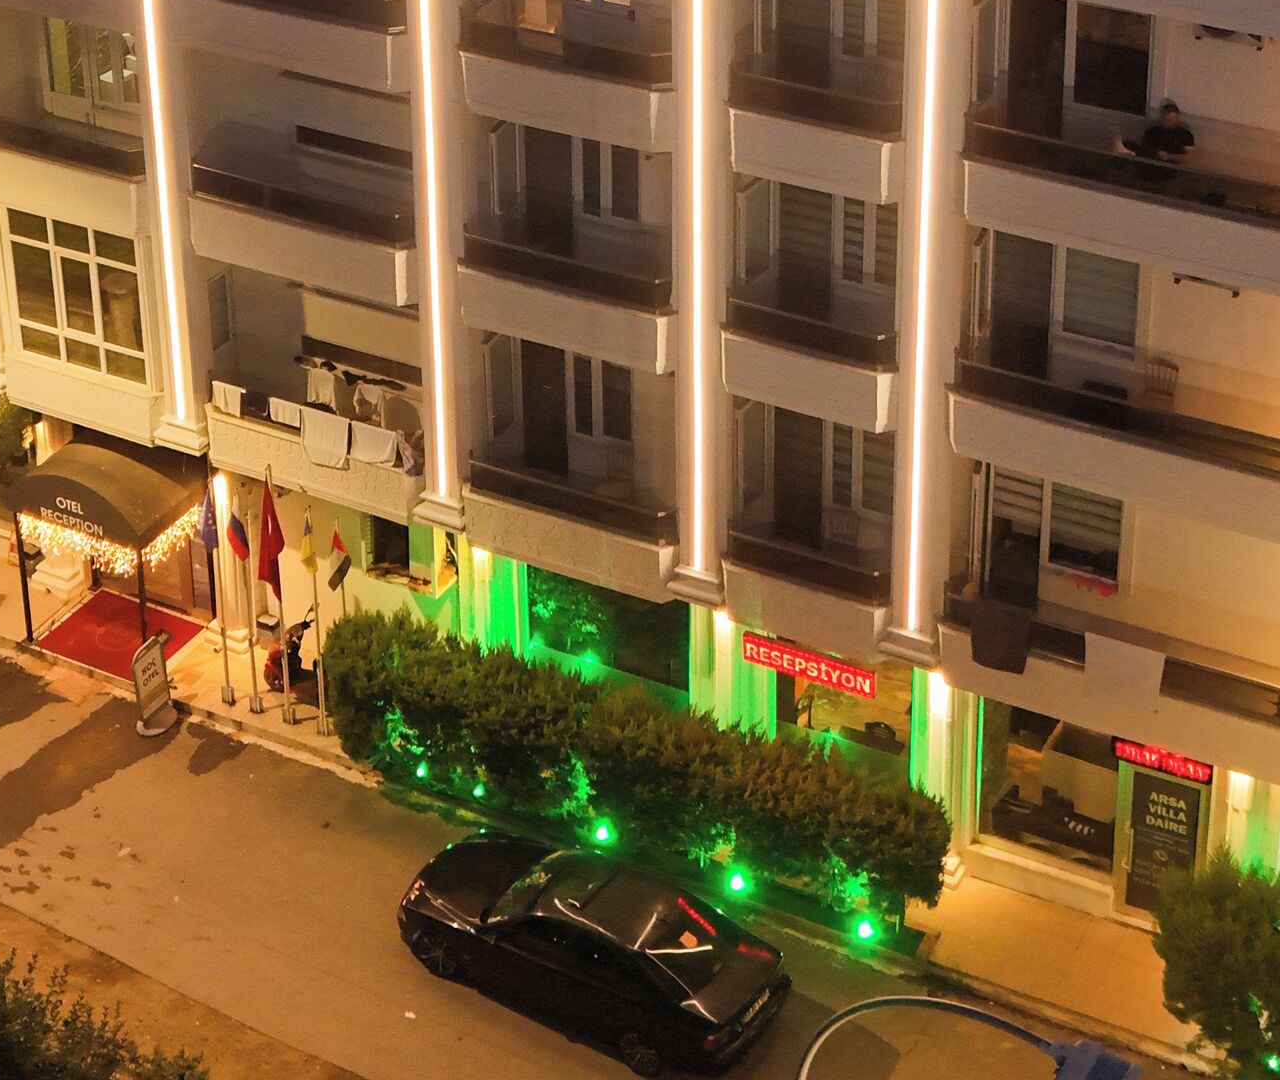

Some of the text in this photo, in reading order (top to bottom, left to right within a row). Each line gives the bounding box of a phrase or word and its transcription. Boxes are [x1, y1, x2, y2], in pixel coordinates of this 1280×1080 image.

[55, 496, 84, 515] OTEL
[40, 506, 103, 537] RECEPTION
[1149, 791, 1187, 811] ARSA
